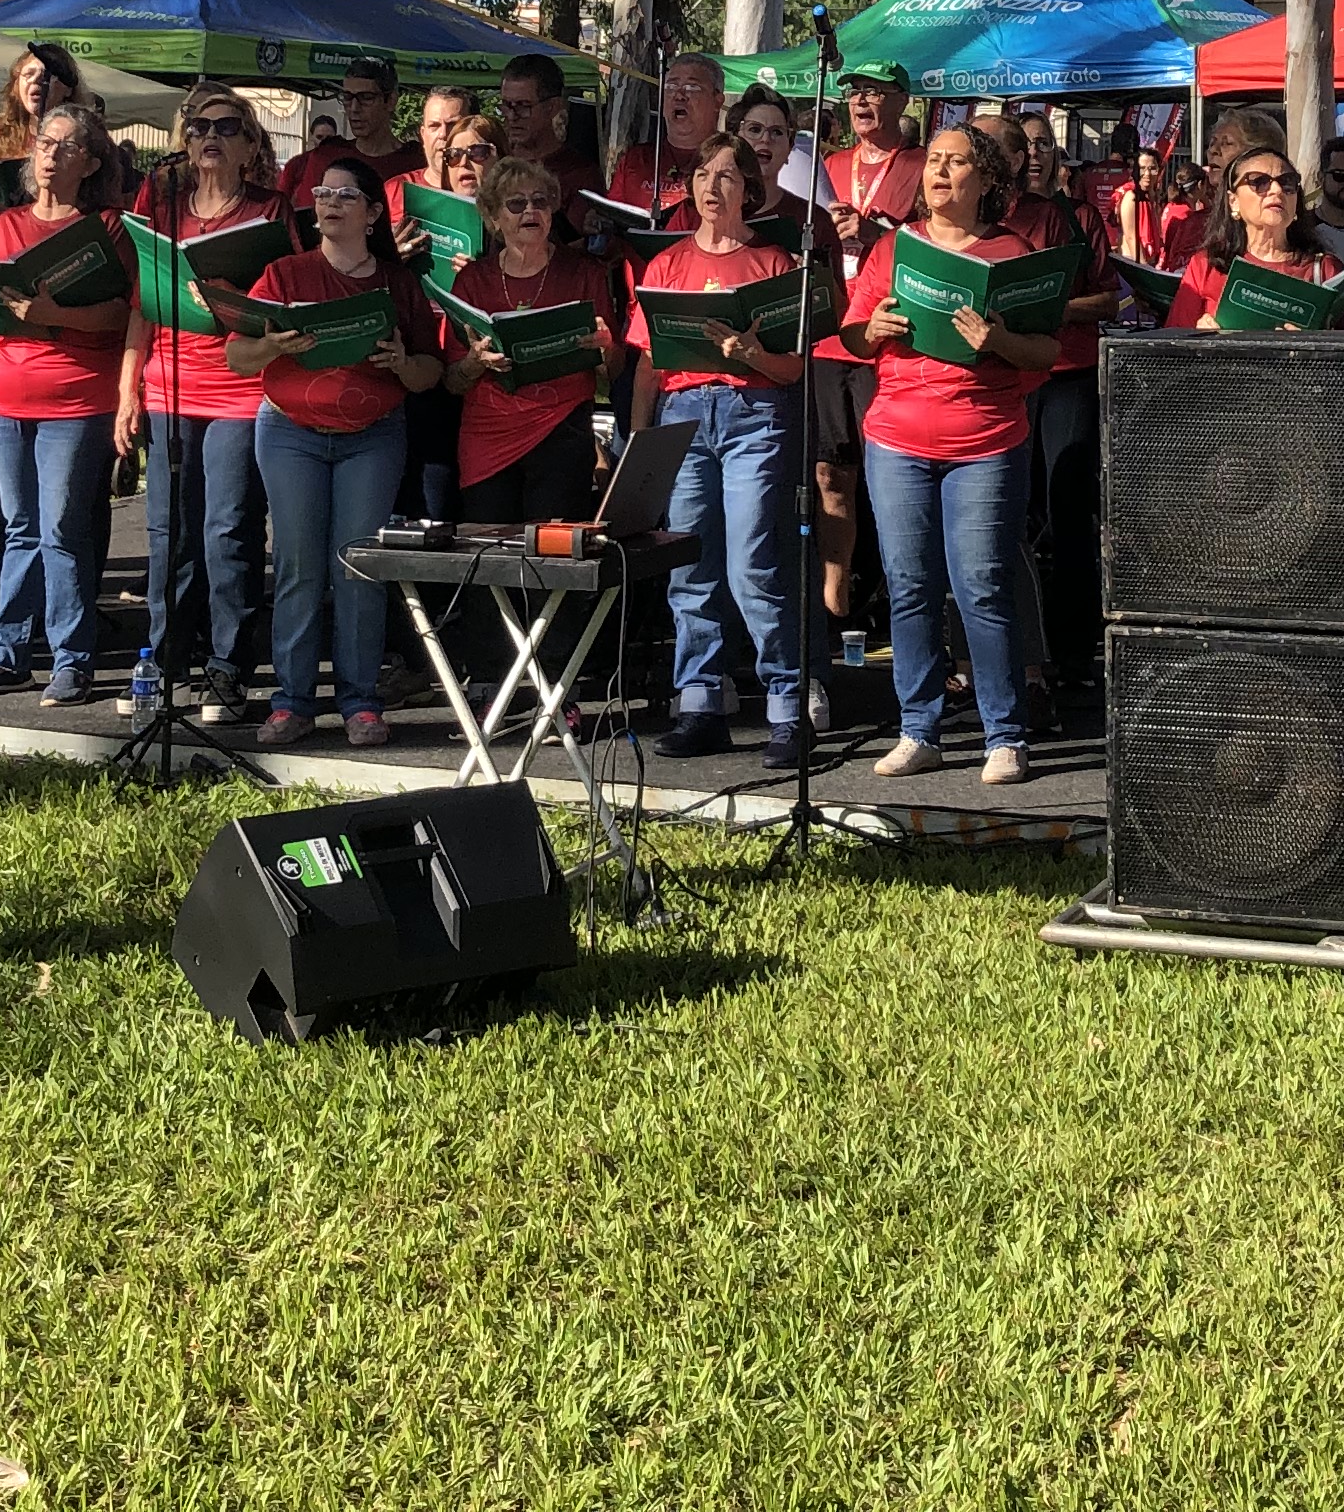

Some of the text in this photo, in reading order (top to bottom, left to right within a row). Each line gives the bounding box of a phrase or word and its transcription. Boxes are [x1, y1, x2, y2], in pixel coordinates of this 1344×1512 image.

[883, 10, 1038, 27] ASSESSORIA ESPORTIVA
[314, 52, 353, 65] Unim
[951, 67, 1101, 92] @igorlorenzzato
[417, 226, 450, 245] nimed
[903, 273, 947, 298] Unimed
[1241, 287, 1288, 309] Unimed
[759, 300, 801, 319] Unime
